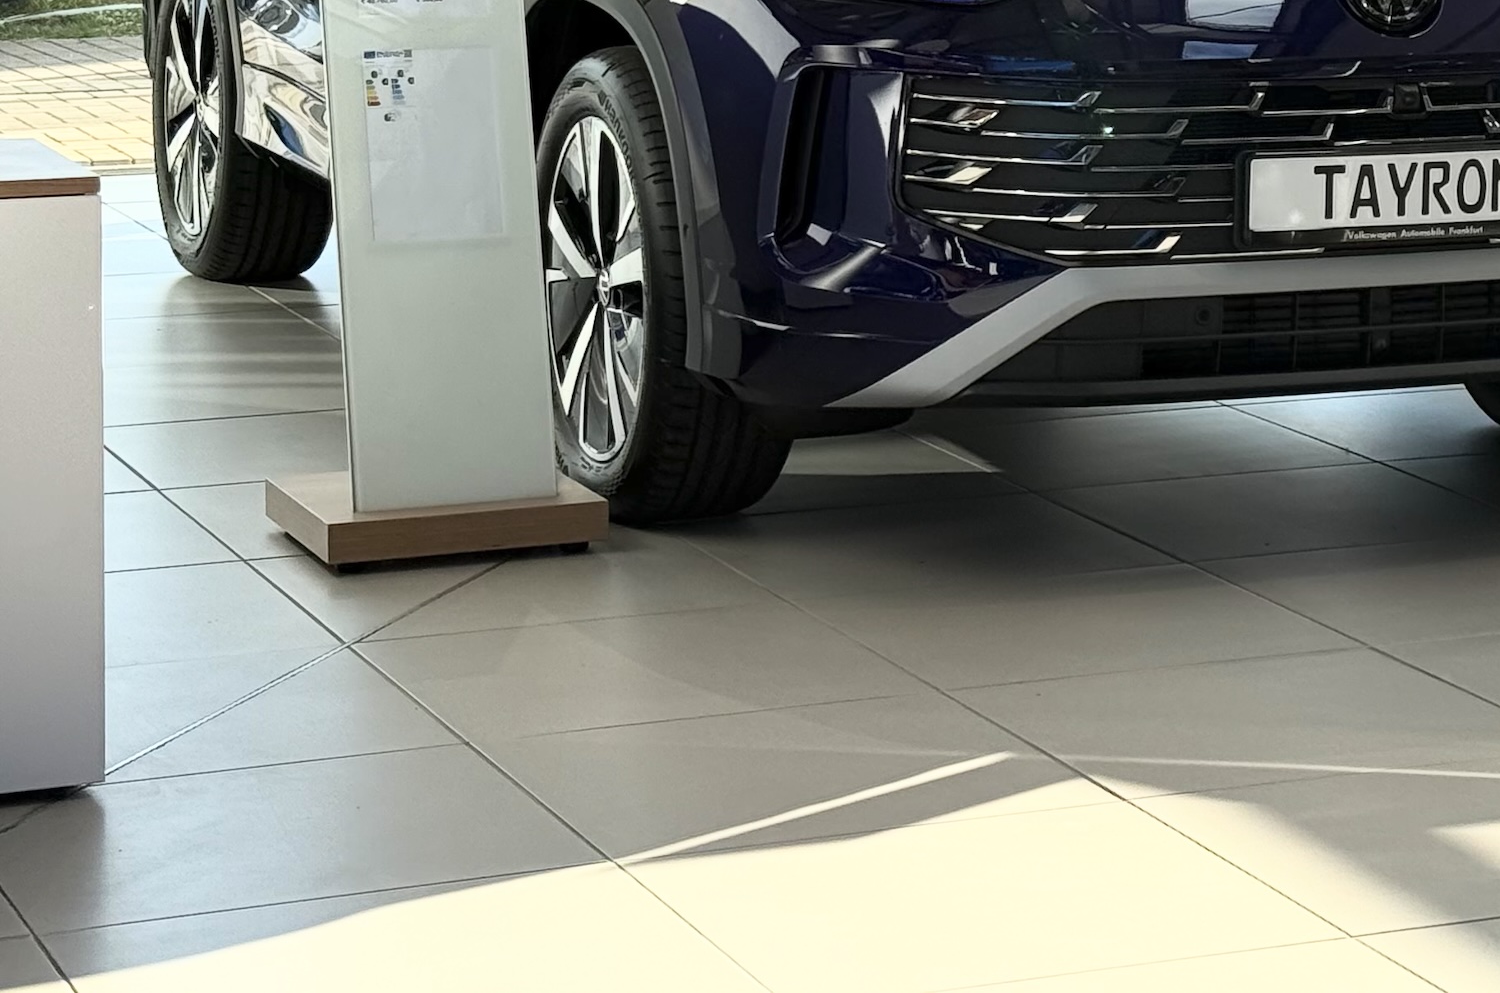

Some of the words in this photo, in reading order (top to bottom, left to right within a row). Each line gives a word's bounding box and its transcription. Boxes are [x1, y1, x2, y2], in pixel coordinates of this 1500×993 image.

[1345, 228, 1398, 241] Volkswagen
[1401, 227, 1446, 238] Automobile
[1449, 226, 1484, 237] Frankfurt
